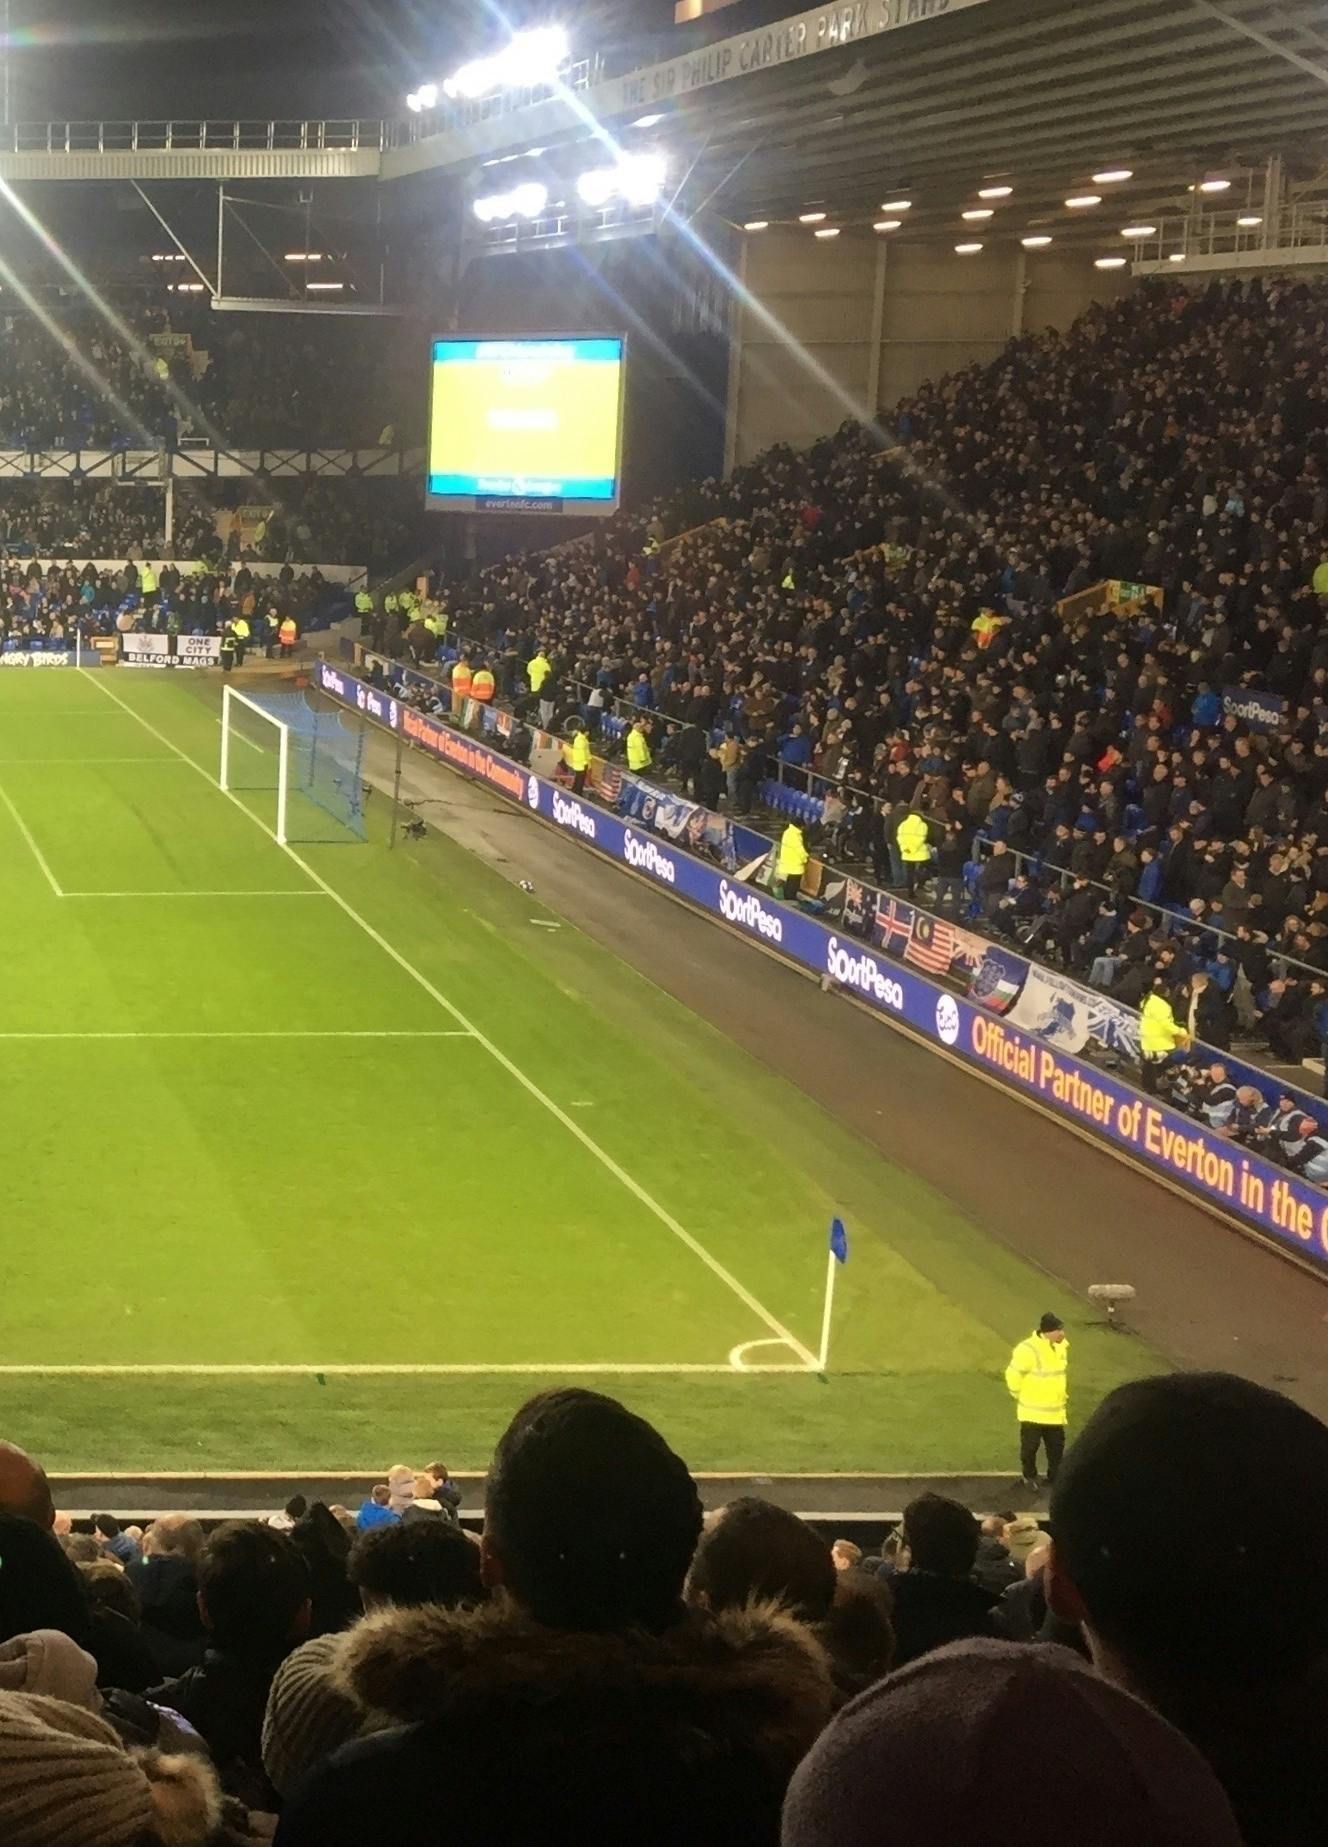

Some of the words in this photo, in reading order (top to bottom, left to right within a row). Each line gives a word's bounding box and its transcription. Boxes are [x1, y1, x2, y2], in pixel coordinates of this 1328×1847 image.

[682, 54, 731, 90] PHILIP
[740, 22, 808, 68] CARTER
[818, 2, 868, 50] PARK
[128, 652, 180, 665] BELFORD
[182, 656, 215, 666] MAGS
[185, 646, 213, 655] CITY
[188, 637, 211, 646] ONE
[553, 790, 596, 838] SportPesa
[624, 829, 675, 883] SportPesa
[719, 879, 782, 942] SportPesa
[827, 936, 903, 1010] SportPesa
[972, 1016, 1035, 1083] Official
[1040, 1050, 1114, 1125] Partner
[1118, 1101, 1141, 1142] of
[1145, 1107, 1234, 1197] Everton
[1241, 1160, 1264, 1213] in
[1271, 1180, 1313, 1240] the
